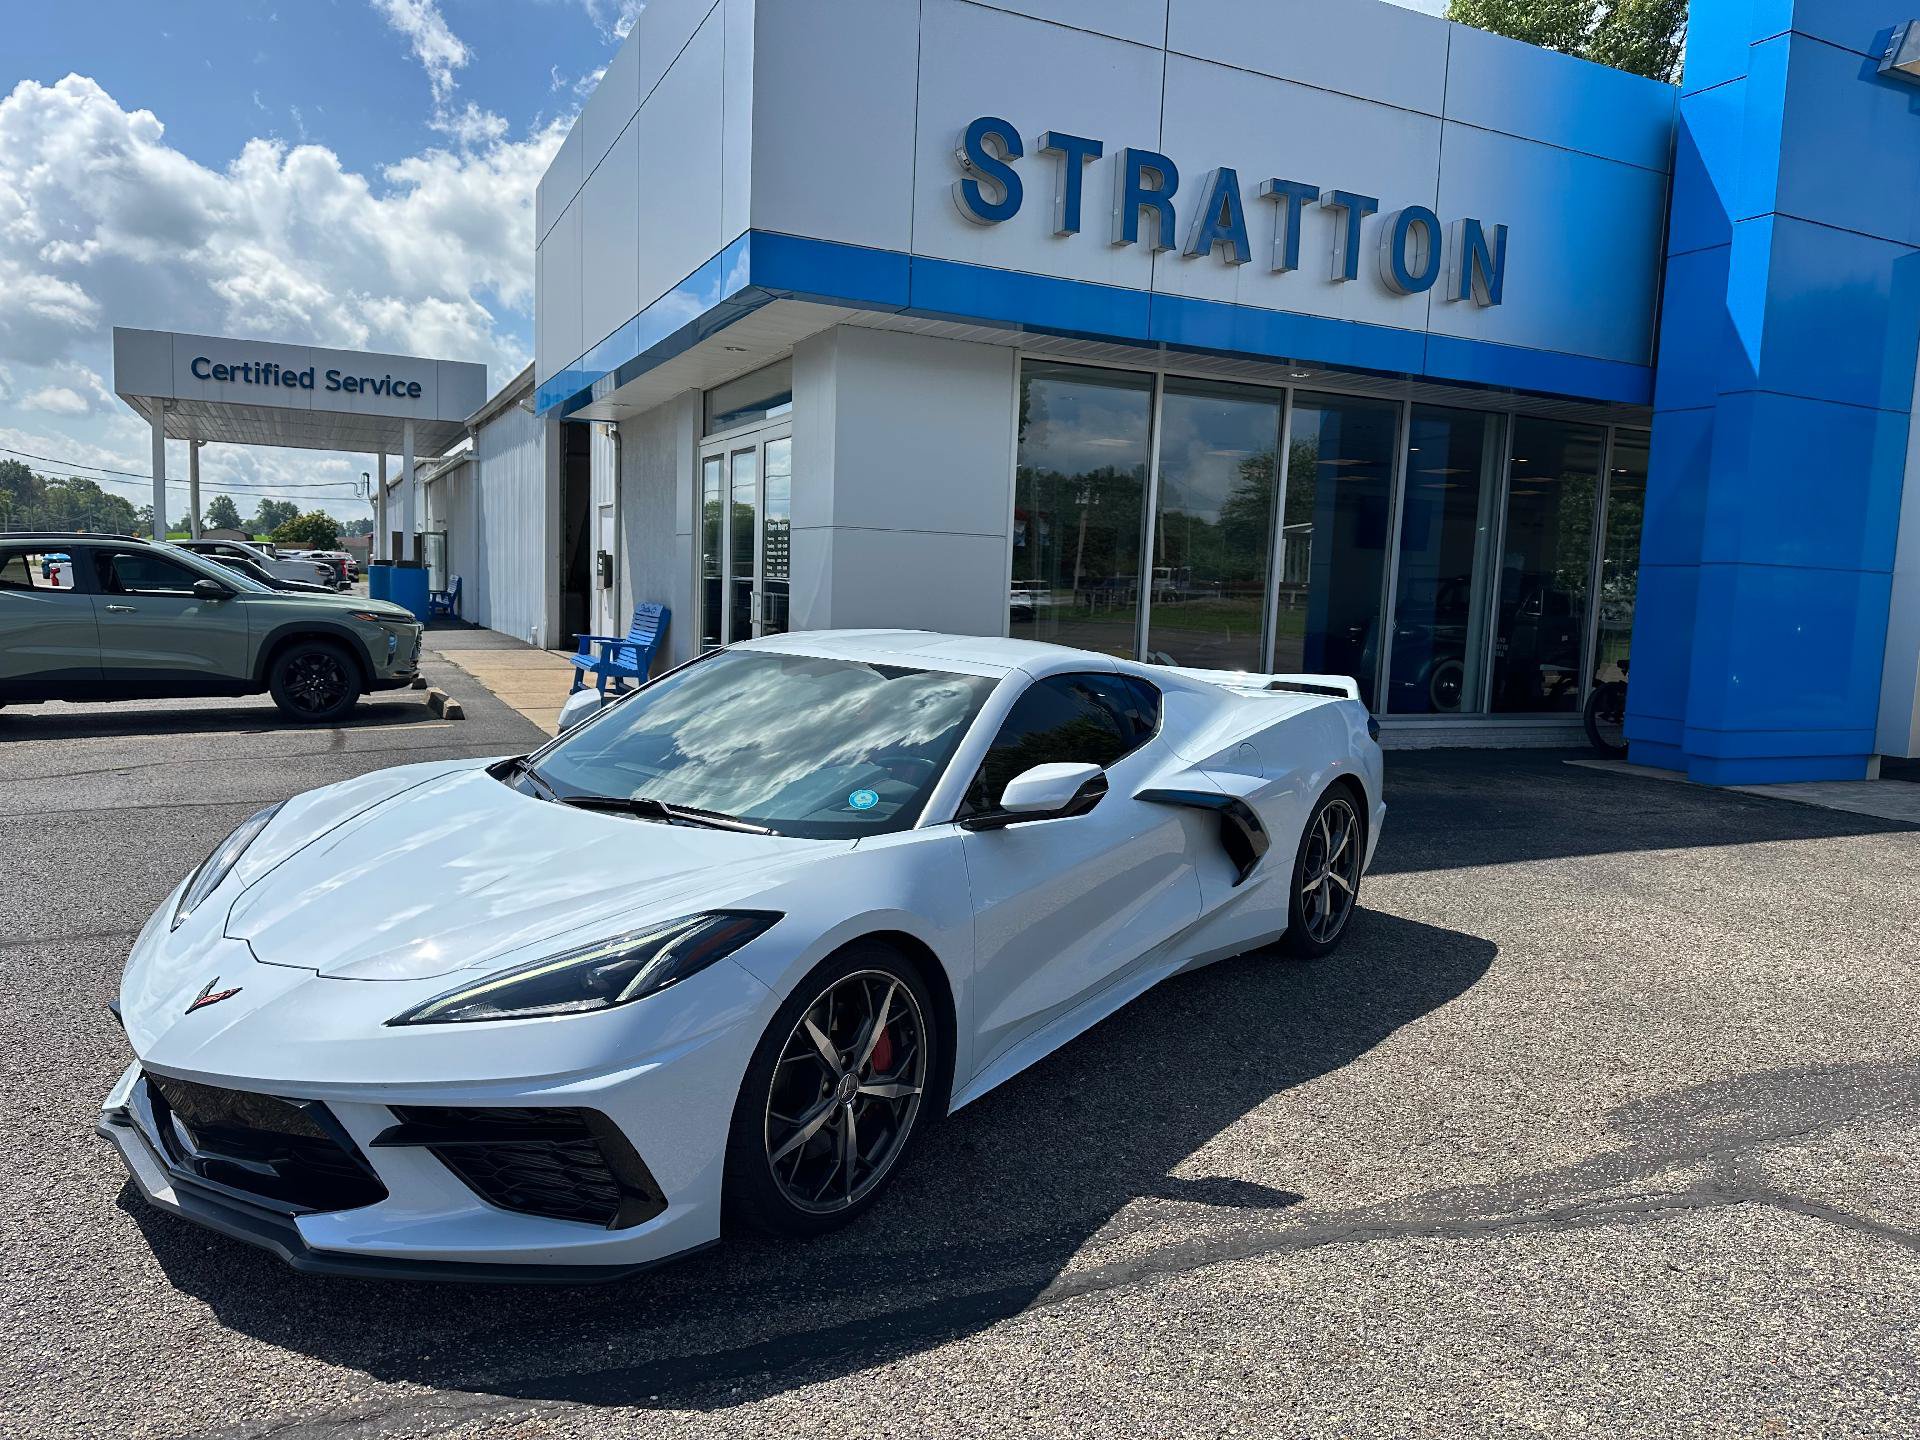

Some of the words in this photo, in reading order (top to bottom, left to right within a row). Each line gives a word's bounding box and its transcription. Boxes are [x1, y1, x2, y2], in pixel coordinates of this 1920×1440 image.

[953, 116, 1509, 309] STRATTON
[190, 356, 315, 390] Certified
[325, 369, 422, 399] Service
